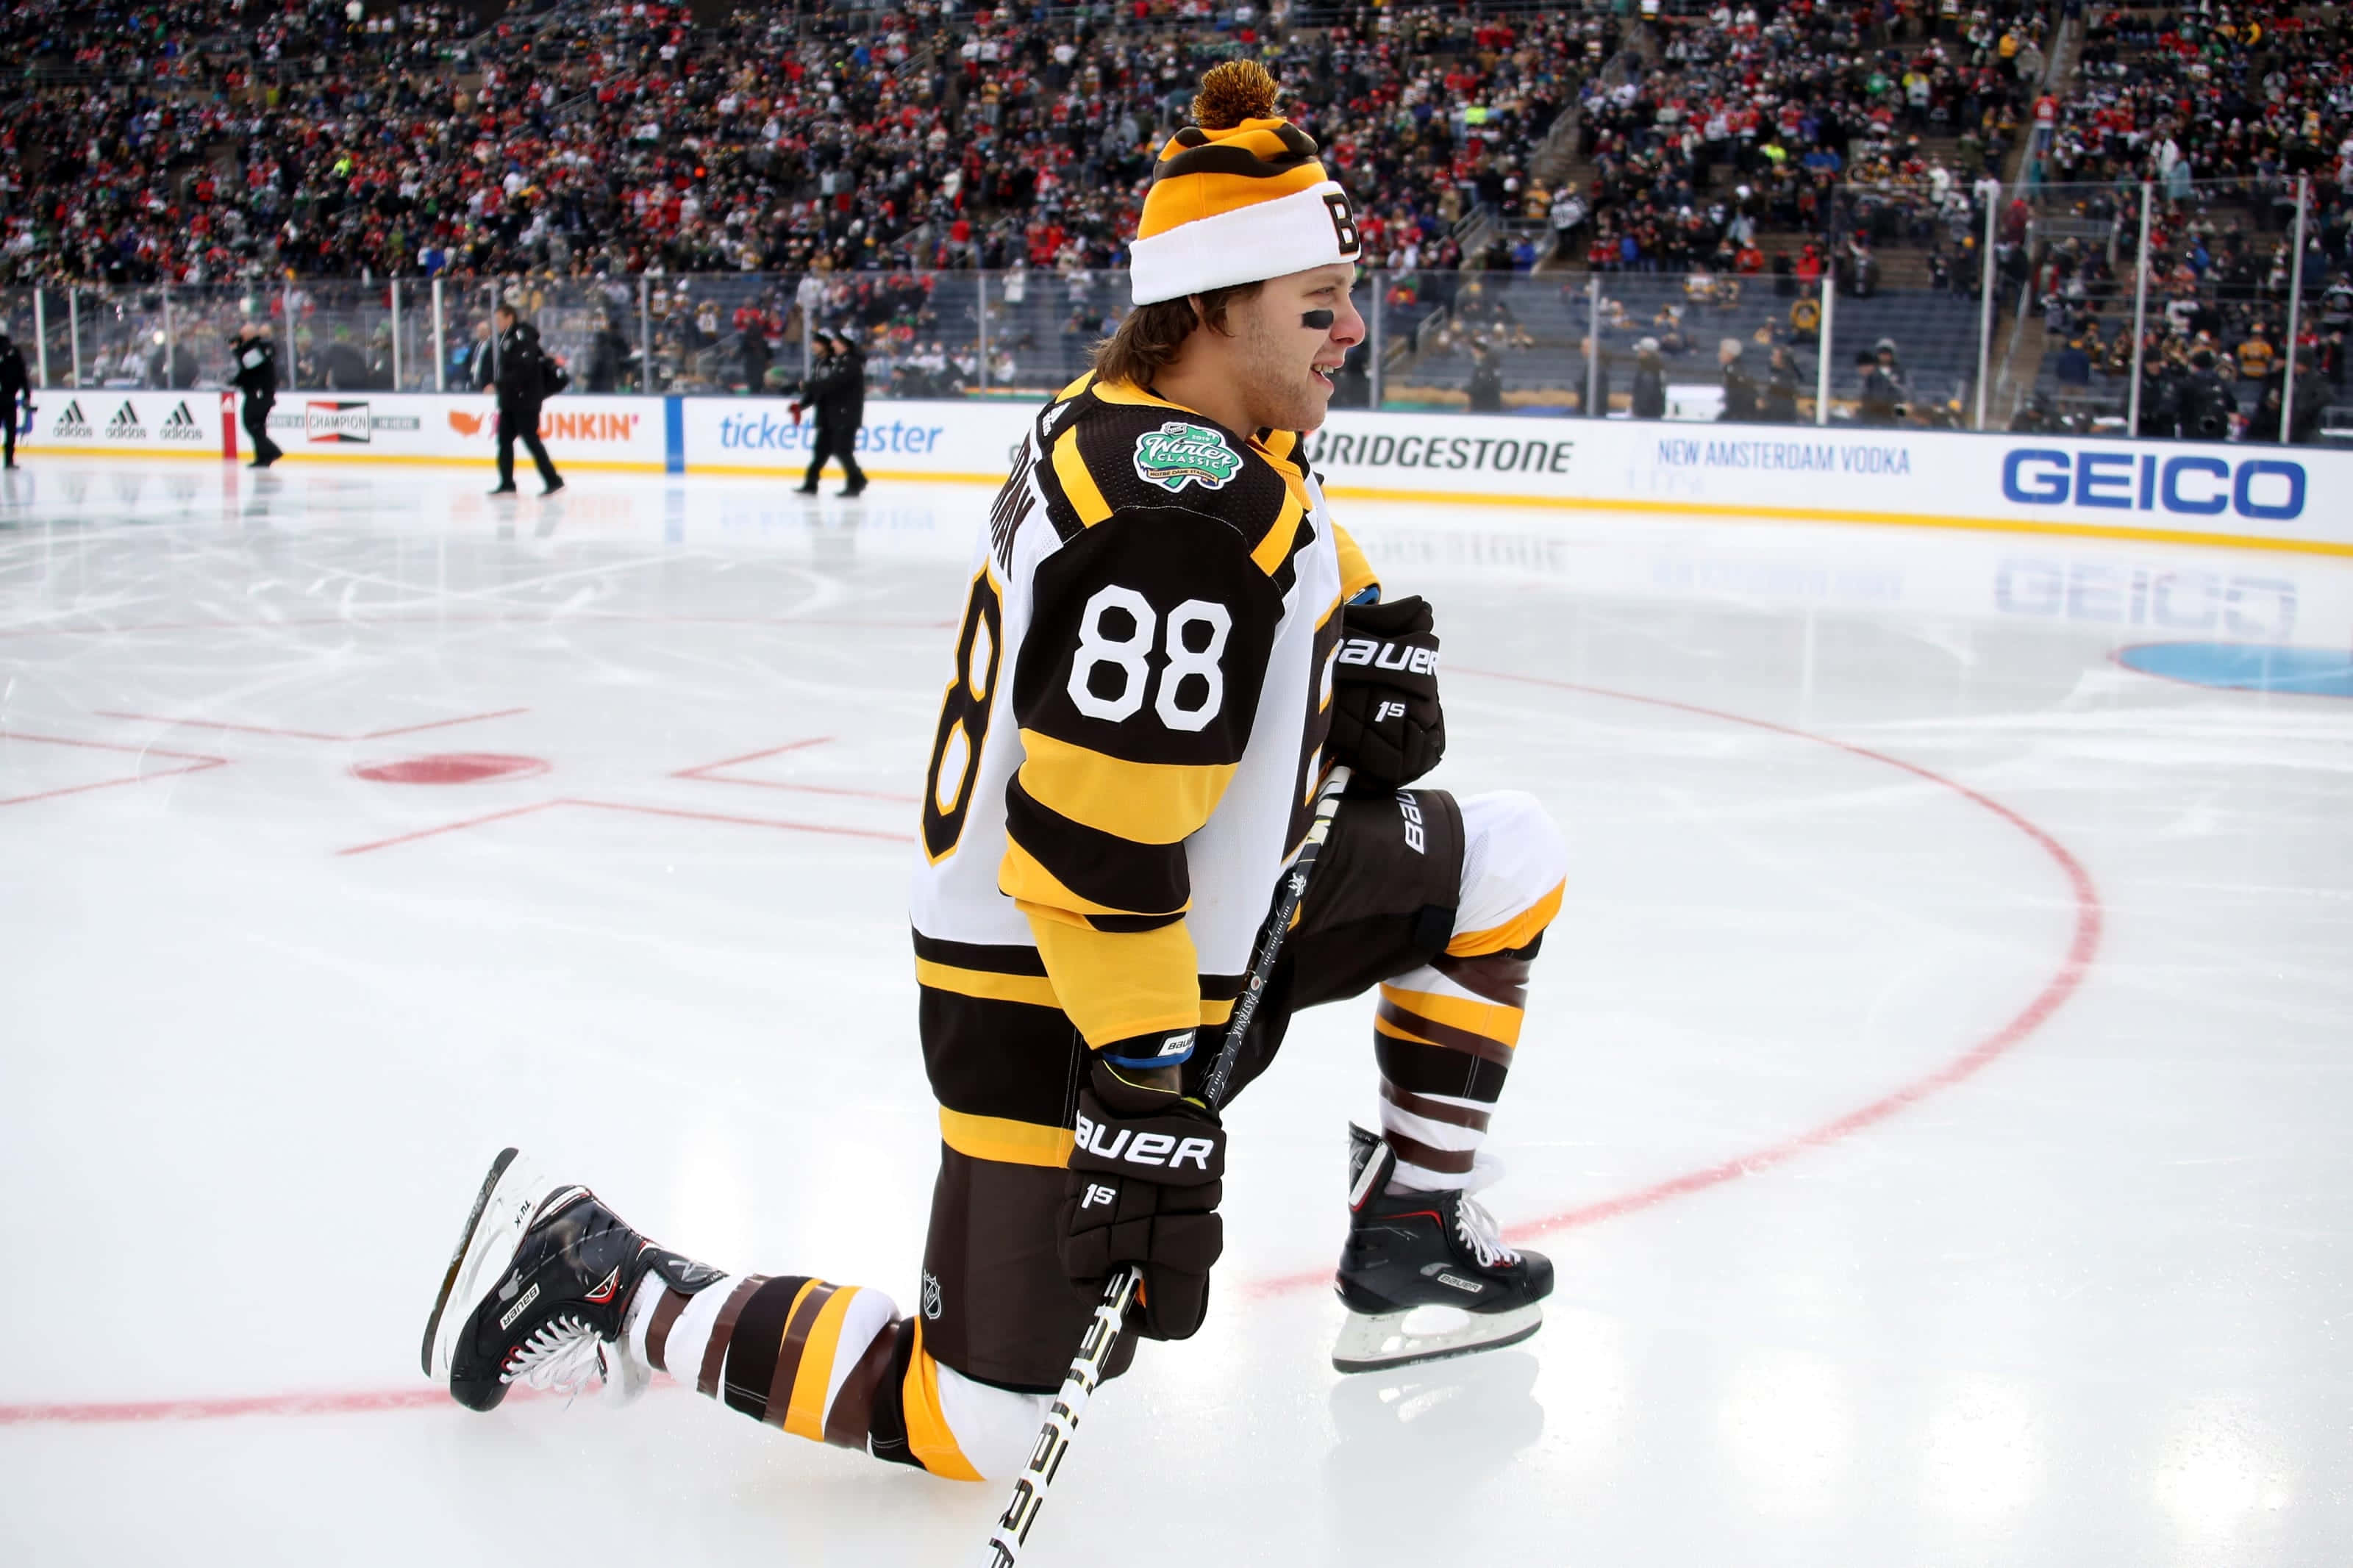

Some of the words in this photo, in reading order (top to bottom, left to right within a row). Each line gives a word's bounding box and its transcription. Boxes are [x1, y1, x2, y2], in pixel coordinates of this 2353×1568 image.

[1322, 192, 1360, 256] B
[53, 424, 93, 438] adidas
[105, 424, 147, 439] adidas
[160, 425, 202, 440] adidas
[309, 415, 366, 430] CHAMPION
[538, 412, 640, 440] UNKIN'
[720, 412, 944, 454] ticketaster
[1146, 436, 1233, 468] Winter
[1157, 453, 1221, 469] CLASSIC
[1657, 439, 1698, 465] NEW
[1704, 441, 1835, 472] AMSTERDAM
[1840, 445, 1911, 475] VODKA
[2002, 448, 2307, 520] GEICO
[1067, 584, 1232, 731] 88
[1334, 638, 1440, 675] AUER
[1375, 701, 1405, 722] 1S
[1074, 1111, 1214, 1170] AUER
[1081, 1184, 1116, 1209] 1S
[1441, 1275, 1479, 1292] BAUER
[502, 1285, 538, 1326] BAUER
